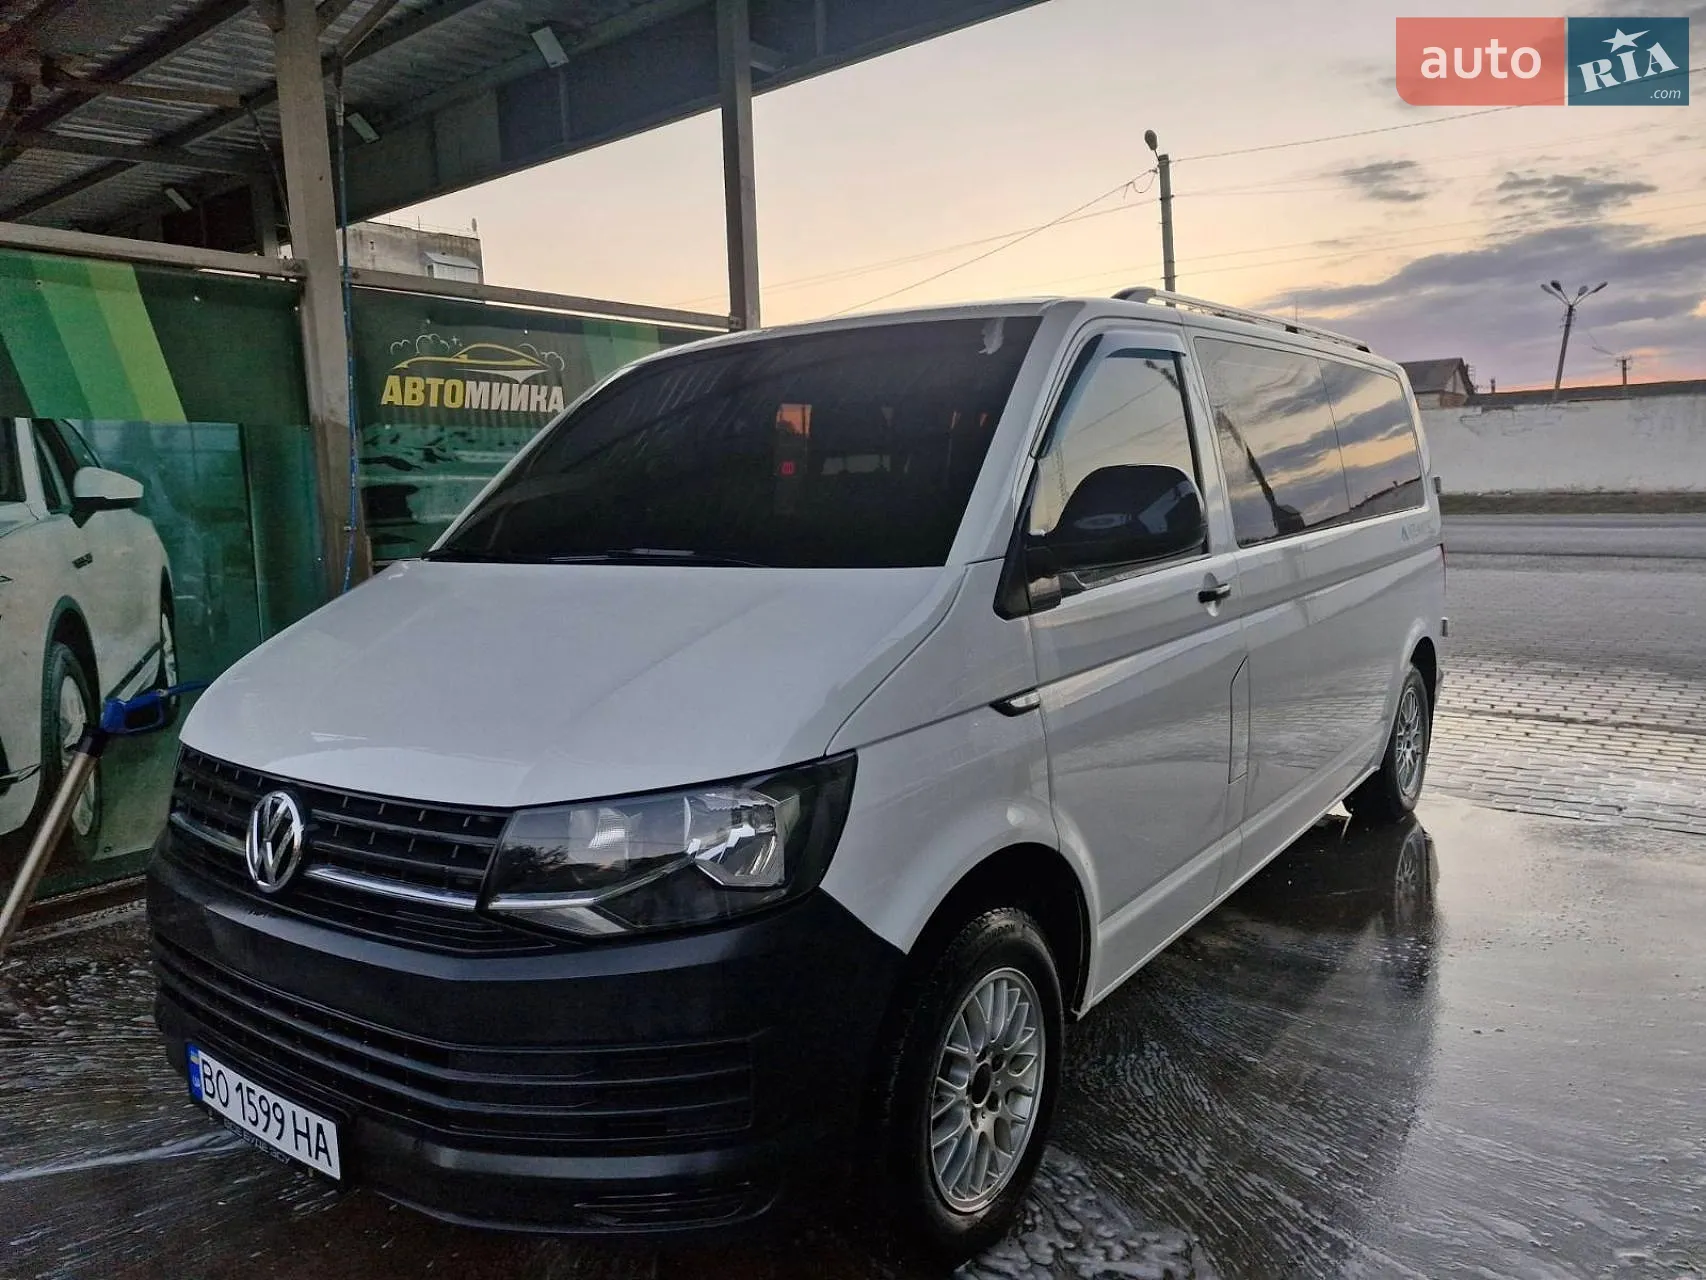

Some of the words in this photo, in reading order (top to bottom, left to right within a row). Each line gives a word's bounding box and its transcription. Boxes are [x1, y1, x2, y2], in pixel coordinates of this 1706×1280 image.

[202, 1060, 229, 1108] BO
[236, 1082, 285, 1140] 1599
[292, 1111, 332, 1167] HA
